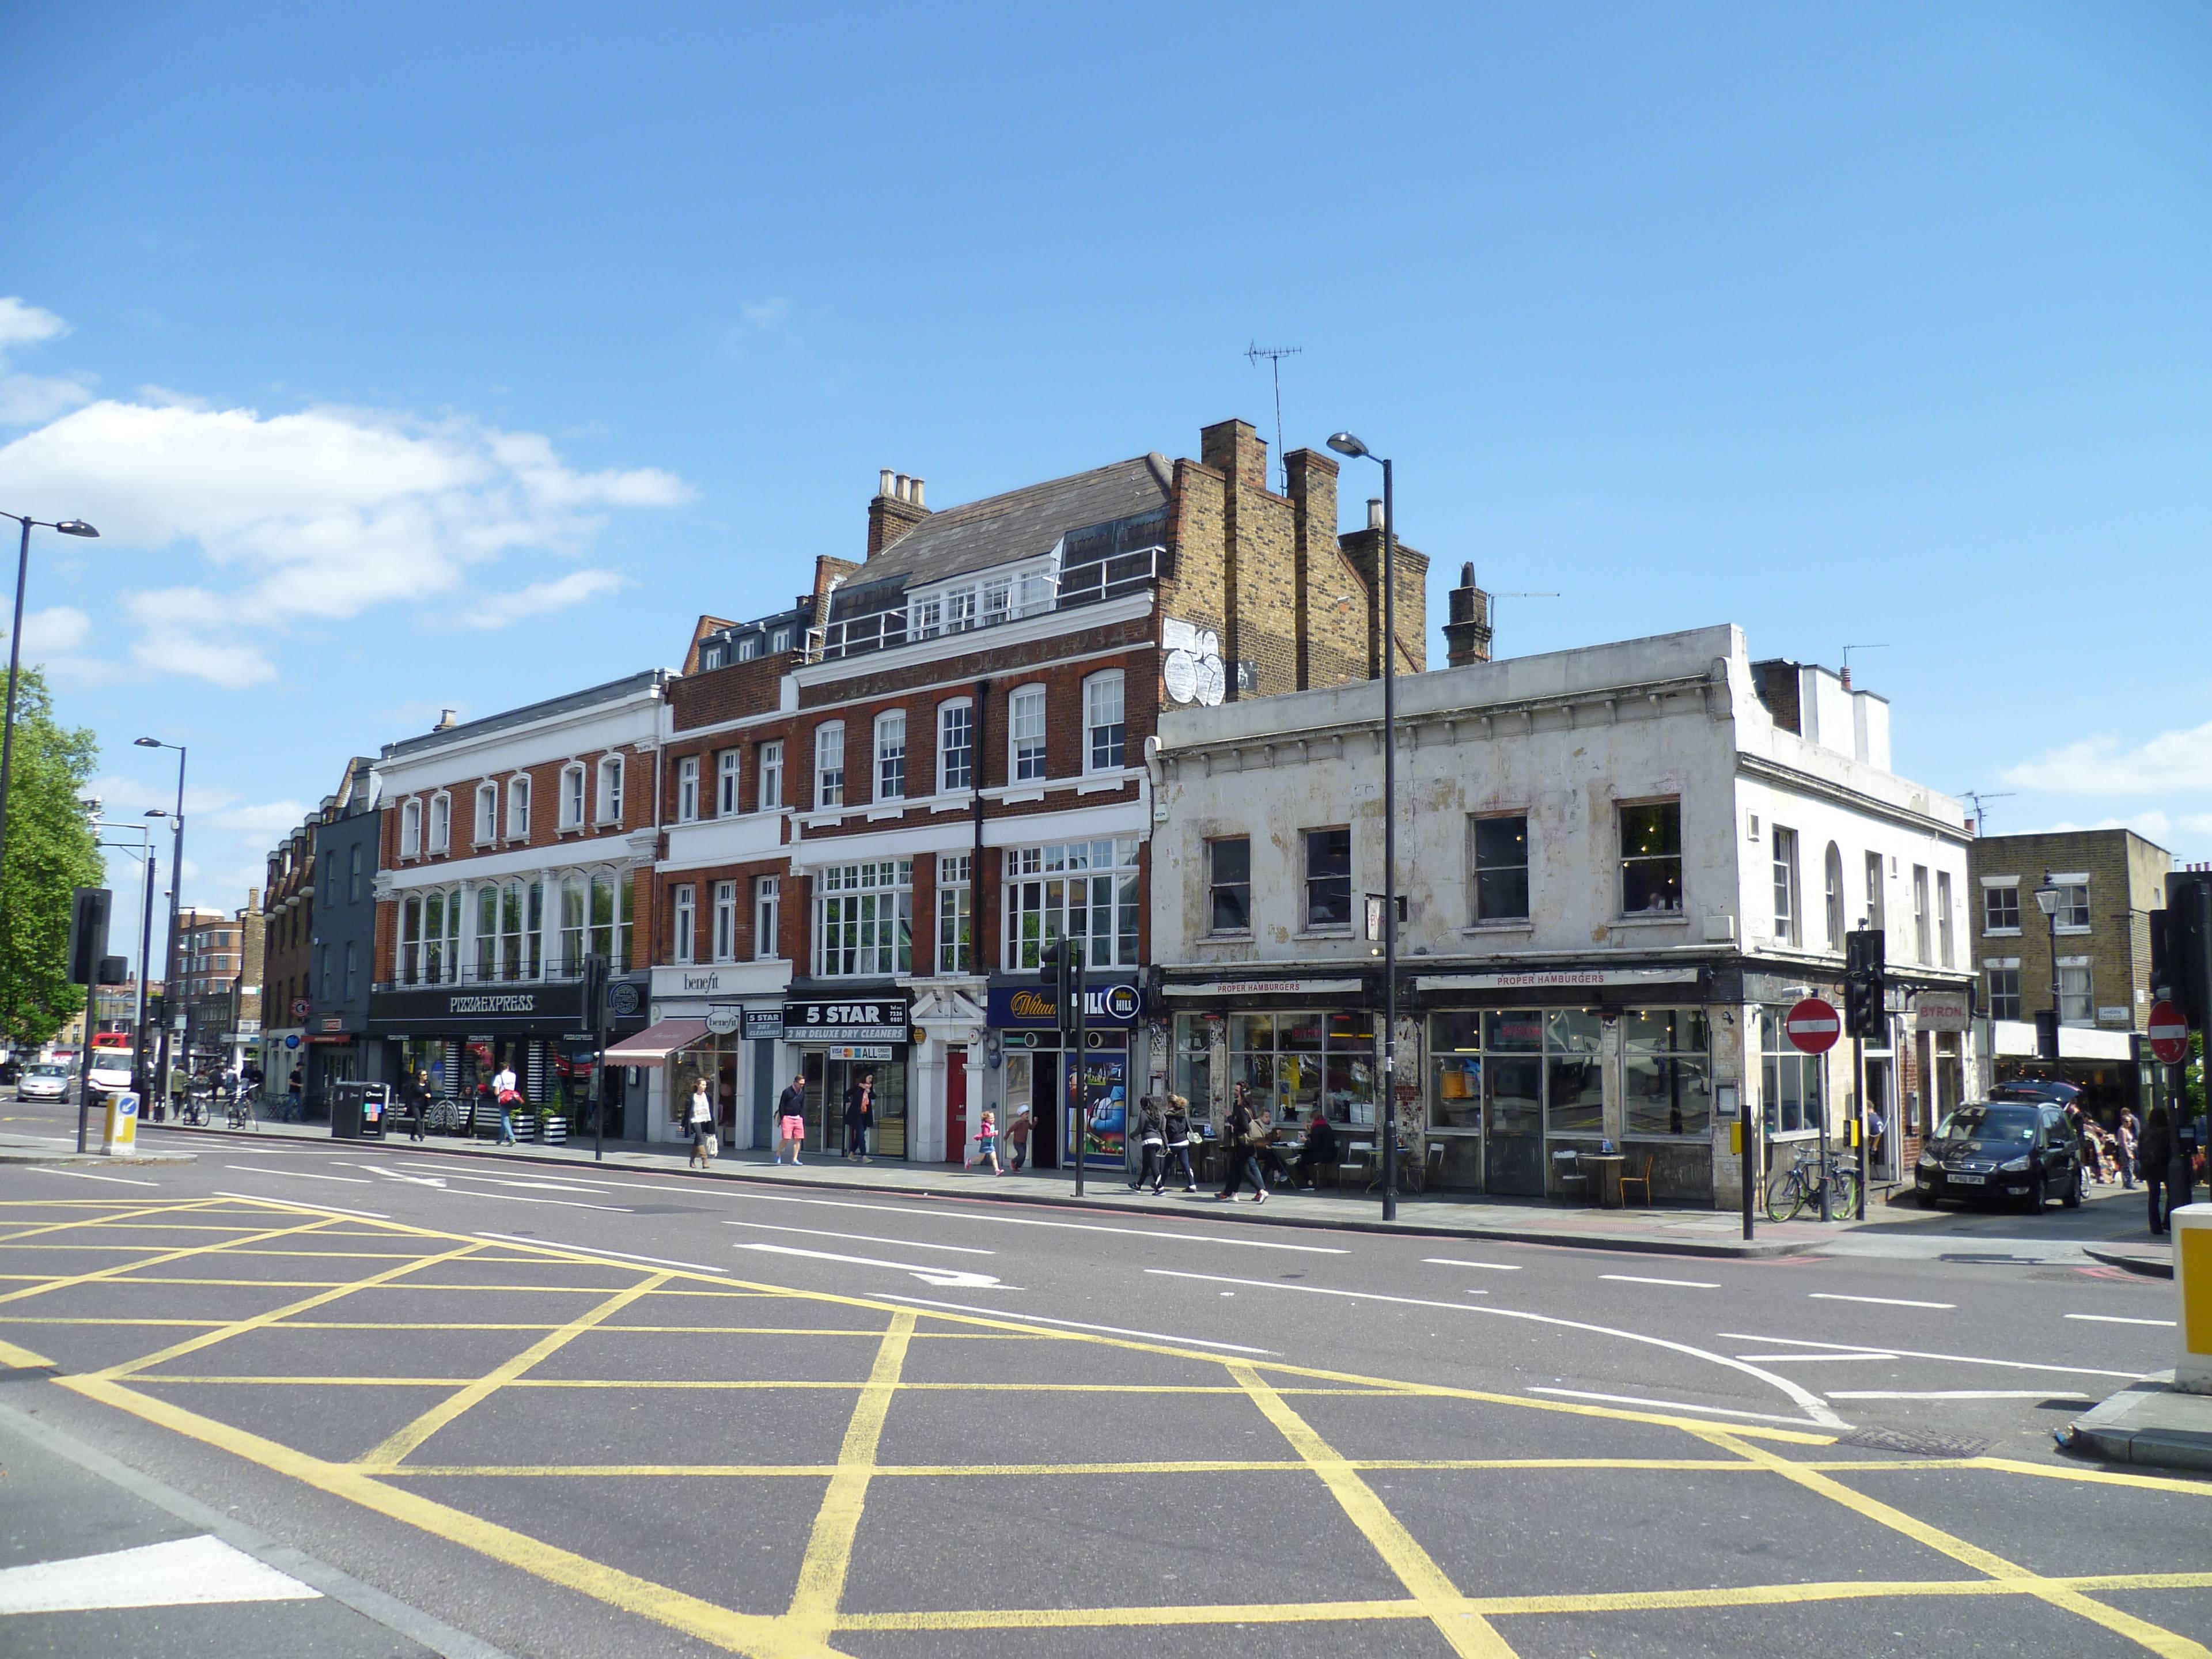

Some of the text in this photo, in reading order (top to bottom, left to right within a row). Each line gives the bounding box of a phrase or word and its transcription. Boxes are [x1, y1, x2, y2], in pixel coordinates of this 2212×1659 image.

[684, 972, 719, 994] benefit
[1498, 975, 1604, 985] PROPER HAMBURGERS
[1217, 984, 1245, 993] PROPER
[450, 995, 533, 1013] PIZZAEXPRESS
[1116, 999, 1132, 1011] HILL
[806, 1006, 880, 1023] 5 STAR
[1921, 1006, 1963, 1018] BYRON
[709, 1017, 738, 1028] benefit
[787, 1029, 903, 1038] 2 HR DELUXE DRY CLEANERS
[862, 1048, 877, 1058] ALL
